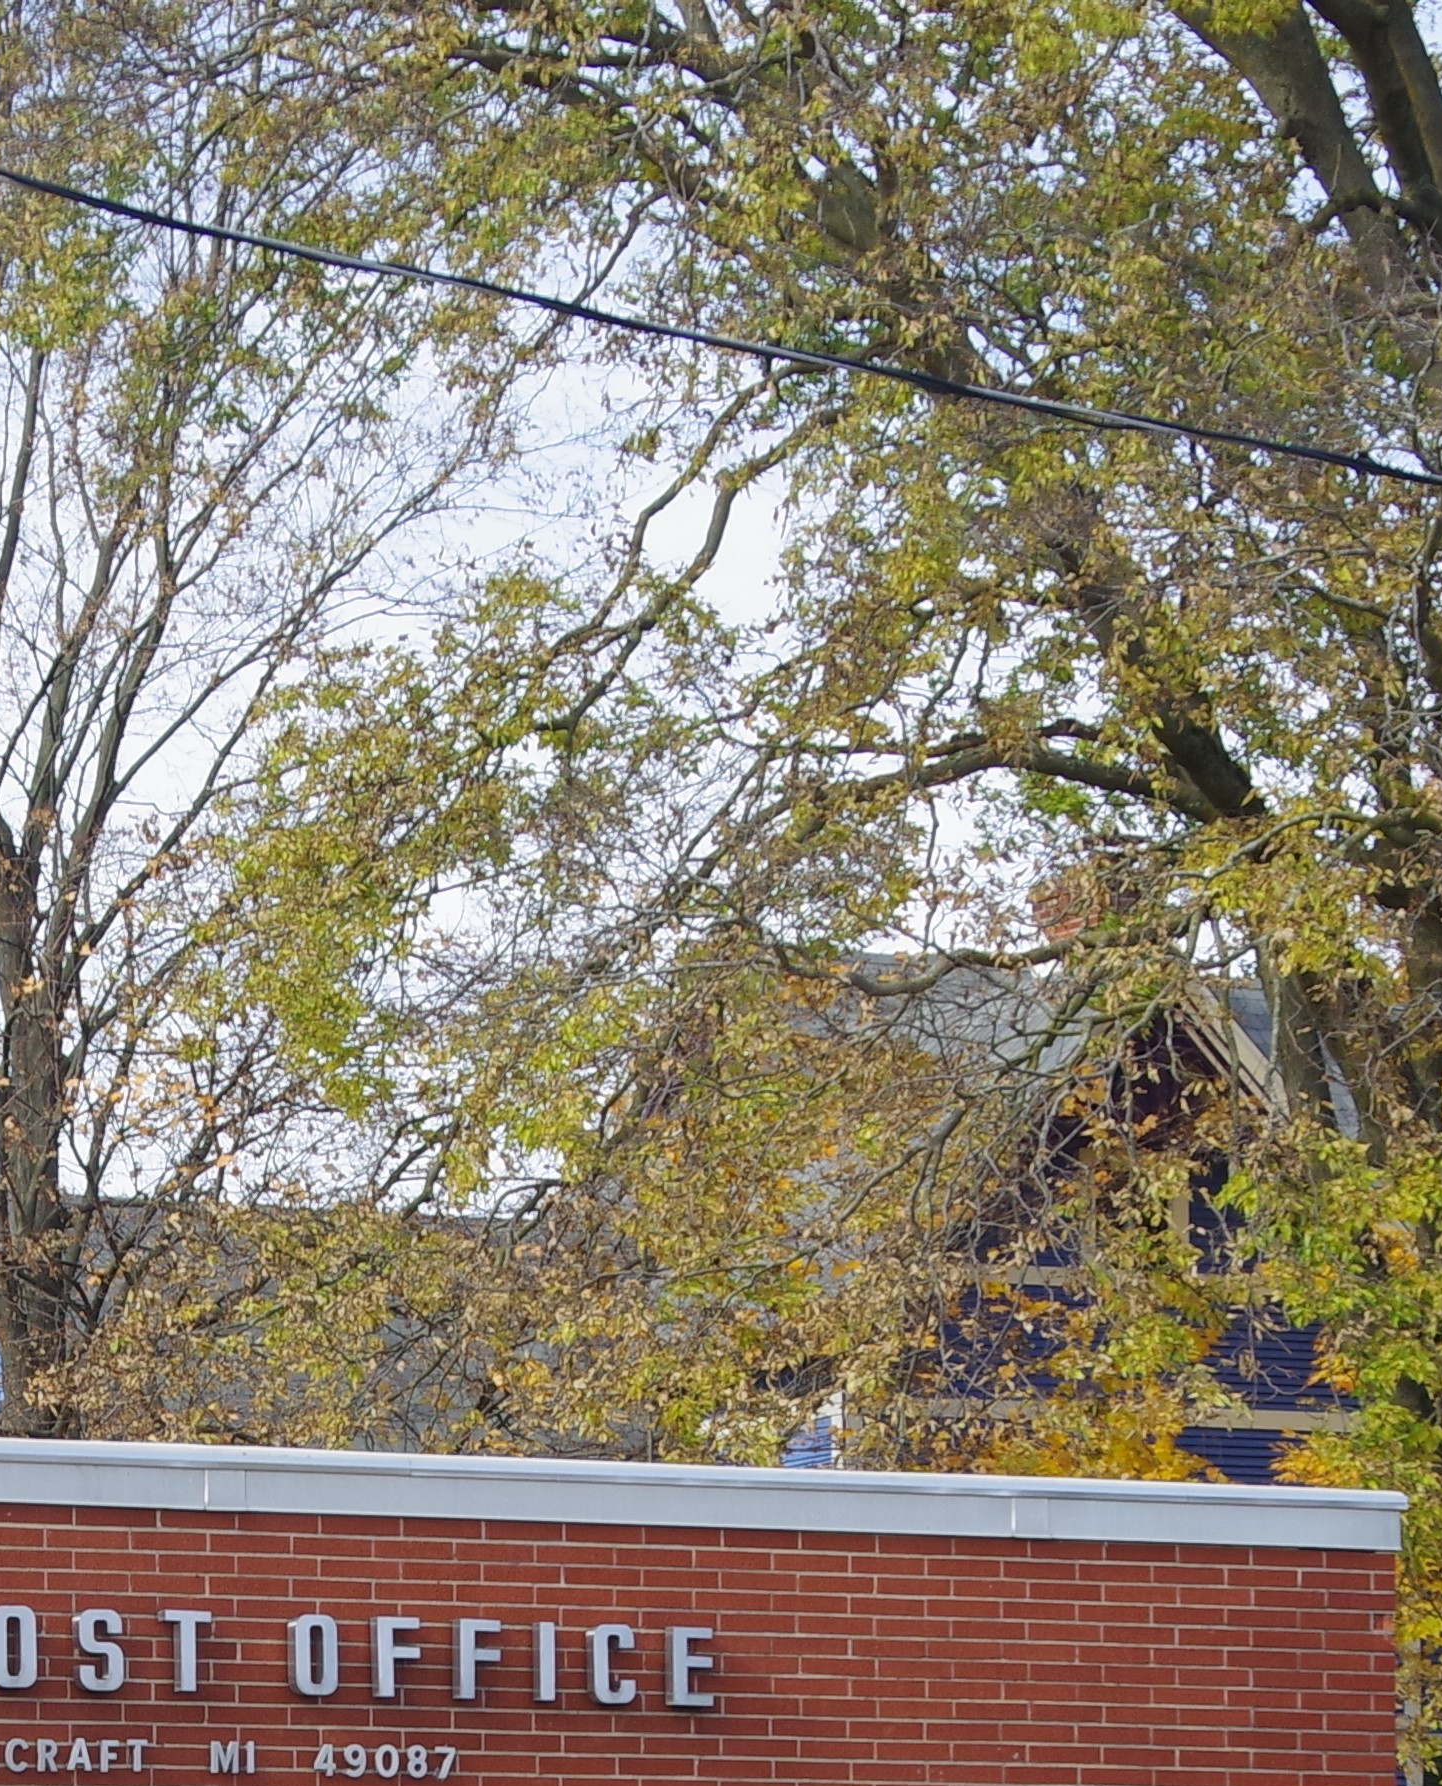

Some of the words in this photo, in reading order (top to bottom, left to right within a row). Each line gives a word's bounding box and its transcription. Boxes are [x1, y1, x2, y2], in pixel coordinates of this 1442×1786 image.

[286, 1613, 715, 1707] OFFICE
[210, 1740, 256, 1775] MI
[313, 1743, 457, 1780] 49087
